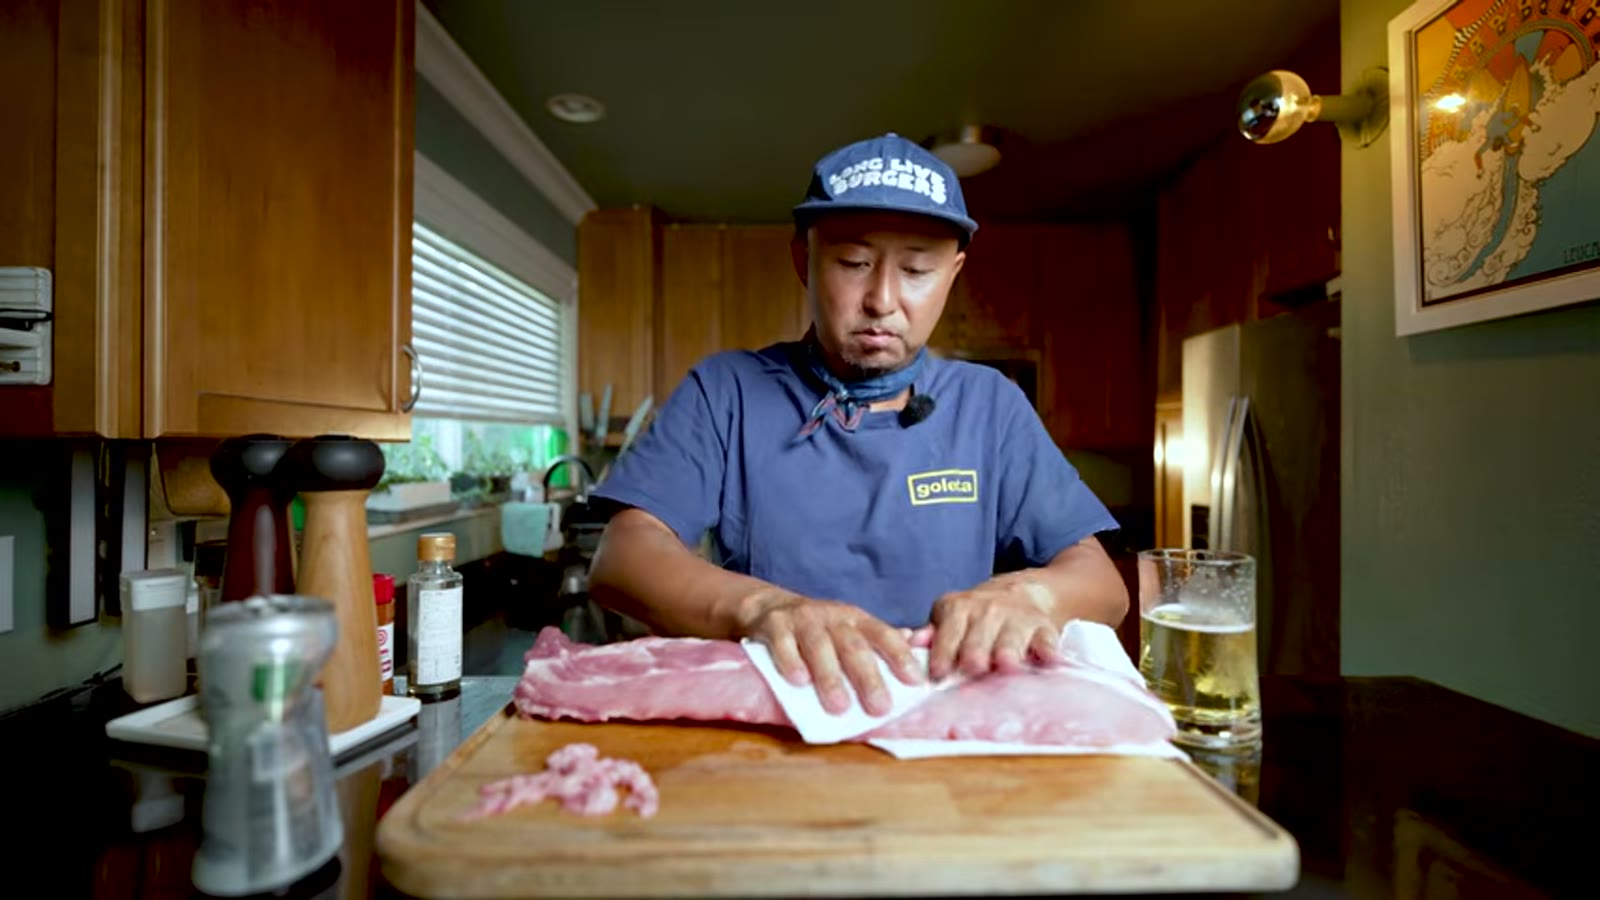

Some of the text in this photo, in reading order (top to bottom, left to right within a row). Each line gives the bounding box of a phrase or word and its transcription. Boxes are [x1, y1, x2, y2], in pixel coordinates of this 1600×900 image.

[829, 157, 945, 185] LONG LIVE
[833, 170, 947, 204] BURGERS
[916, 478, 972, 498] goleta
